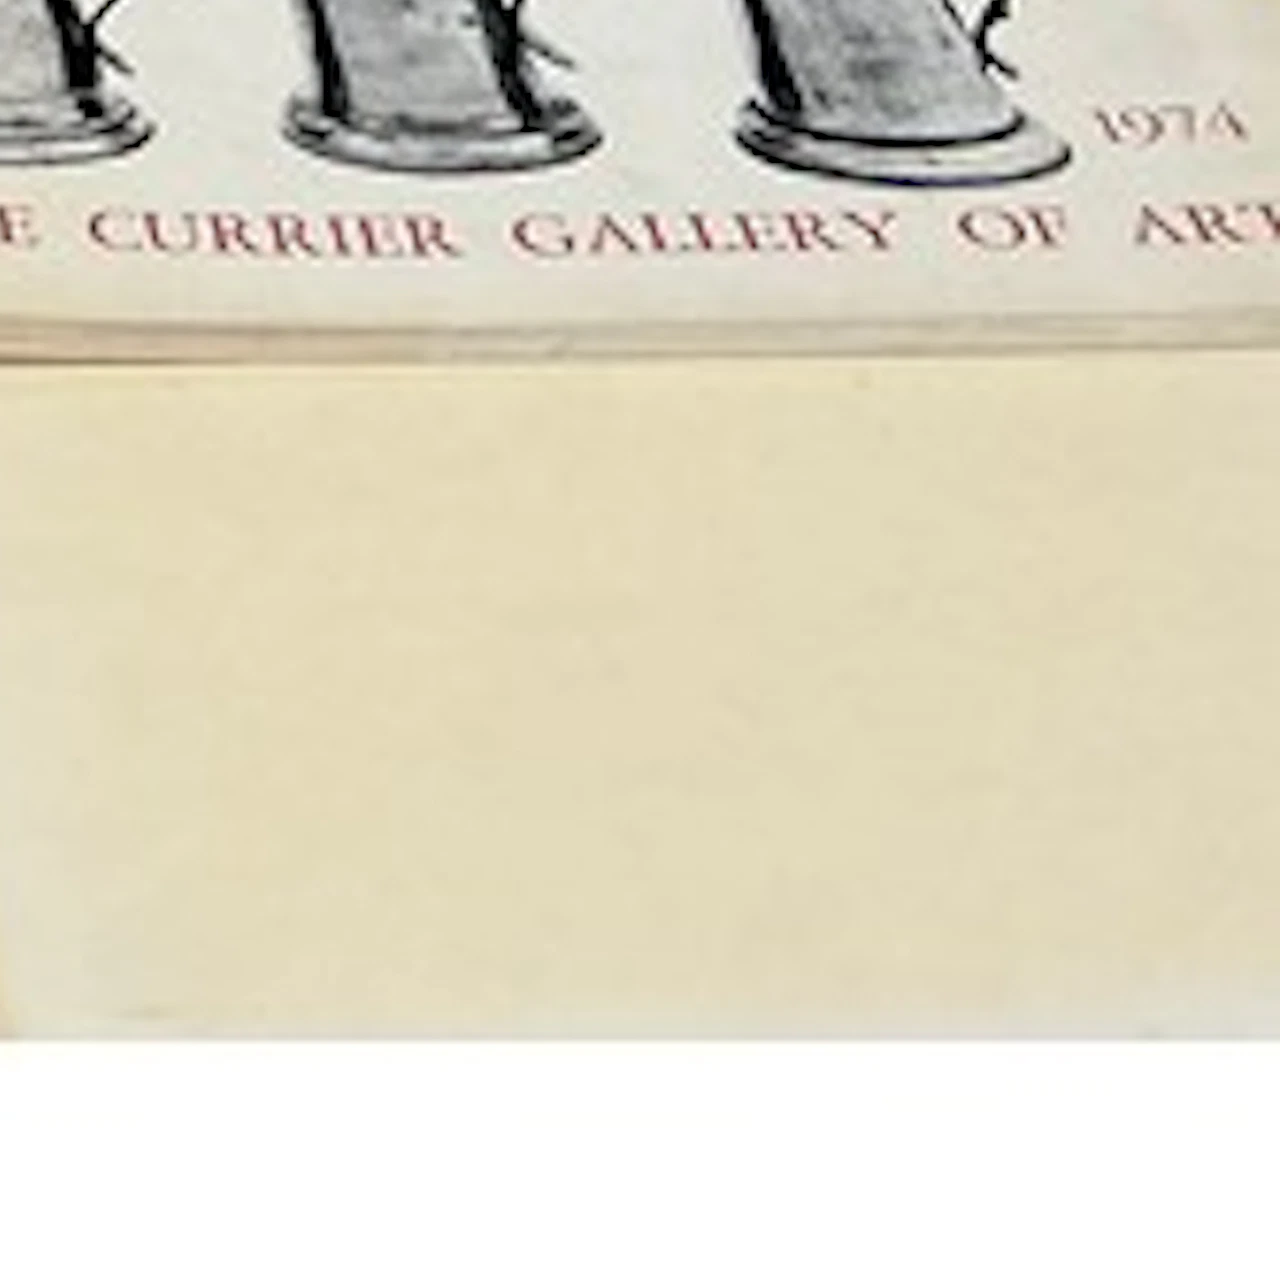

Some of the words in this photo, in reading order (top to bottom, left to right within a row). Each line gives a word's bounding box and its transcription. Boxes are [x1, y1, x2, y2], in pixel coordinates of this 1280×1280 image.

[1093, 100, 1253, 148] 1974
[88, 209, 464, 260] CURRIER
[511, 208, 899, 260] GALLERY
[956, 204, 1069, 248] OF
[1132, 201, 1280, 248] ART
